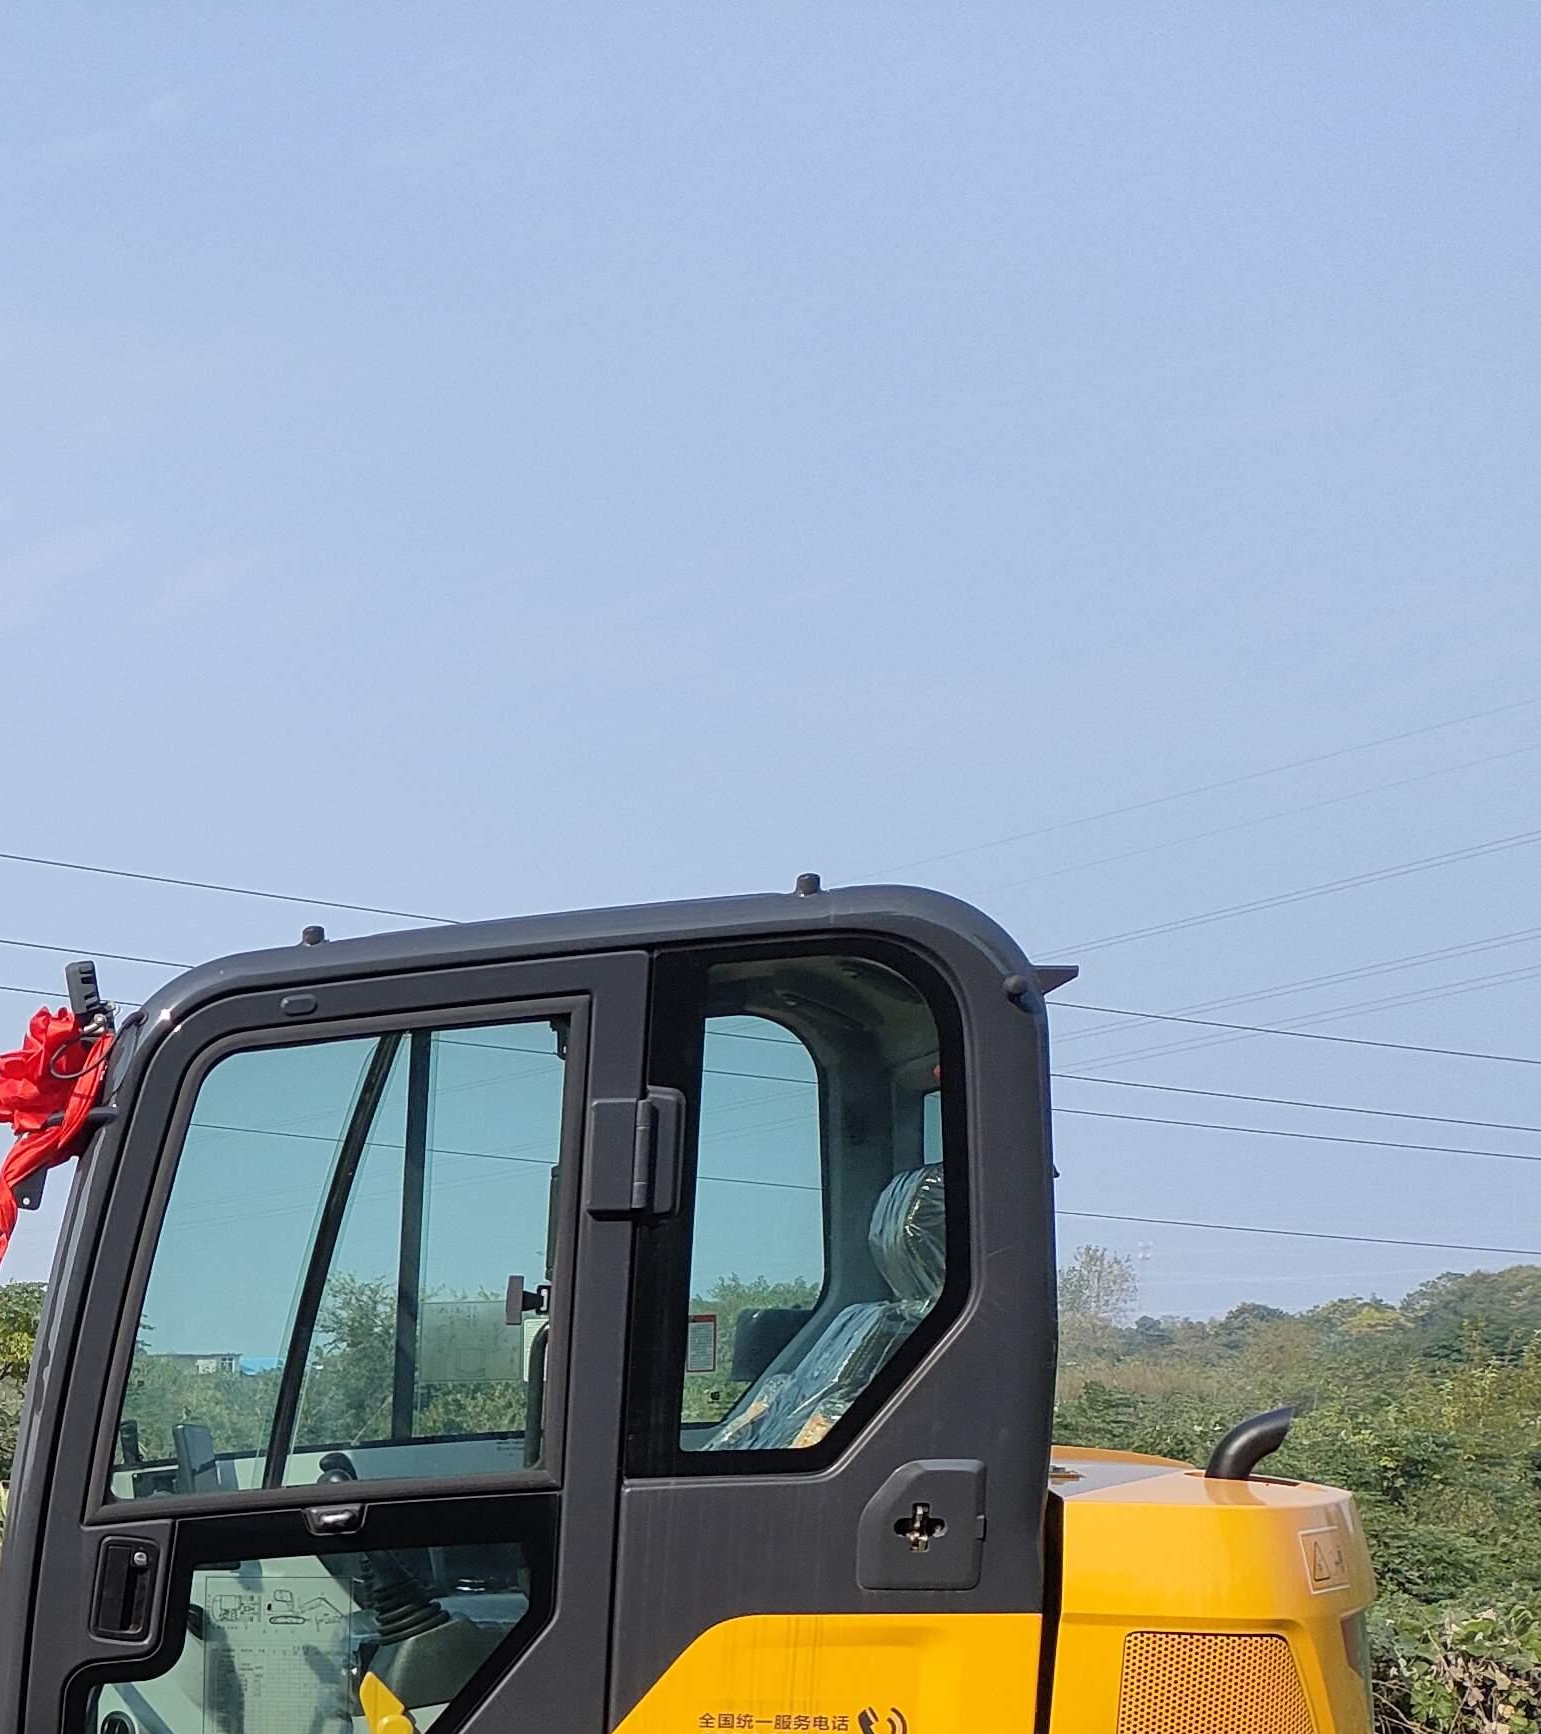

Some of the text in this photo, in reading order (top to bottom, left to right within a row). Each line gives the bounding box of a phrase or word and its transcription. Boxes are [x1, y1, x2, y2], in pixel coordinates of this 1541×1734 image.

[698, 1713, 850, 1731] 全国统一服务电话
